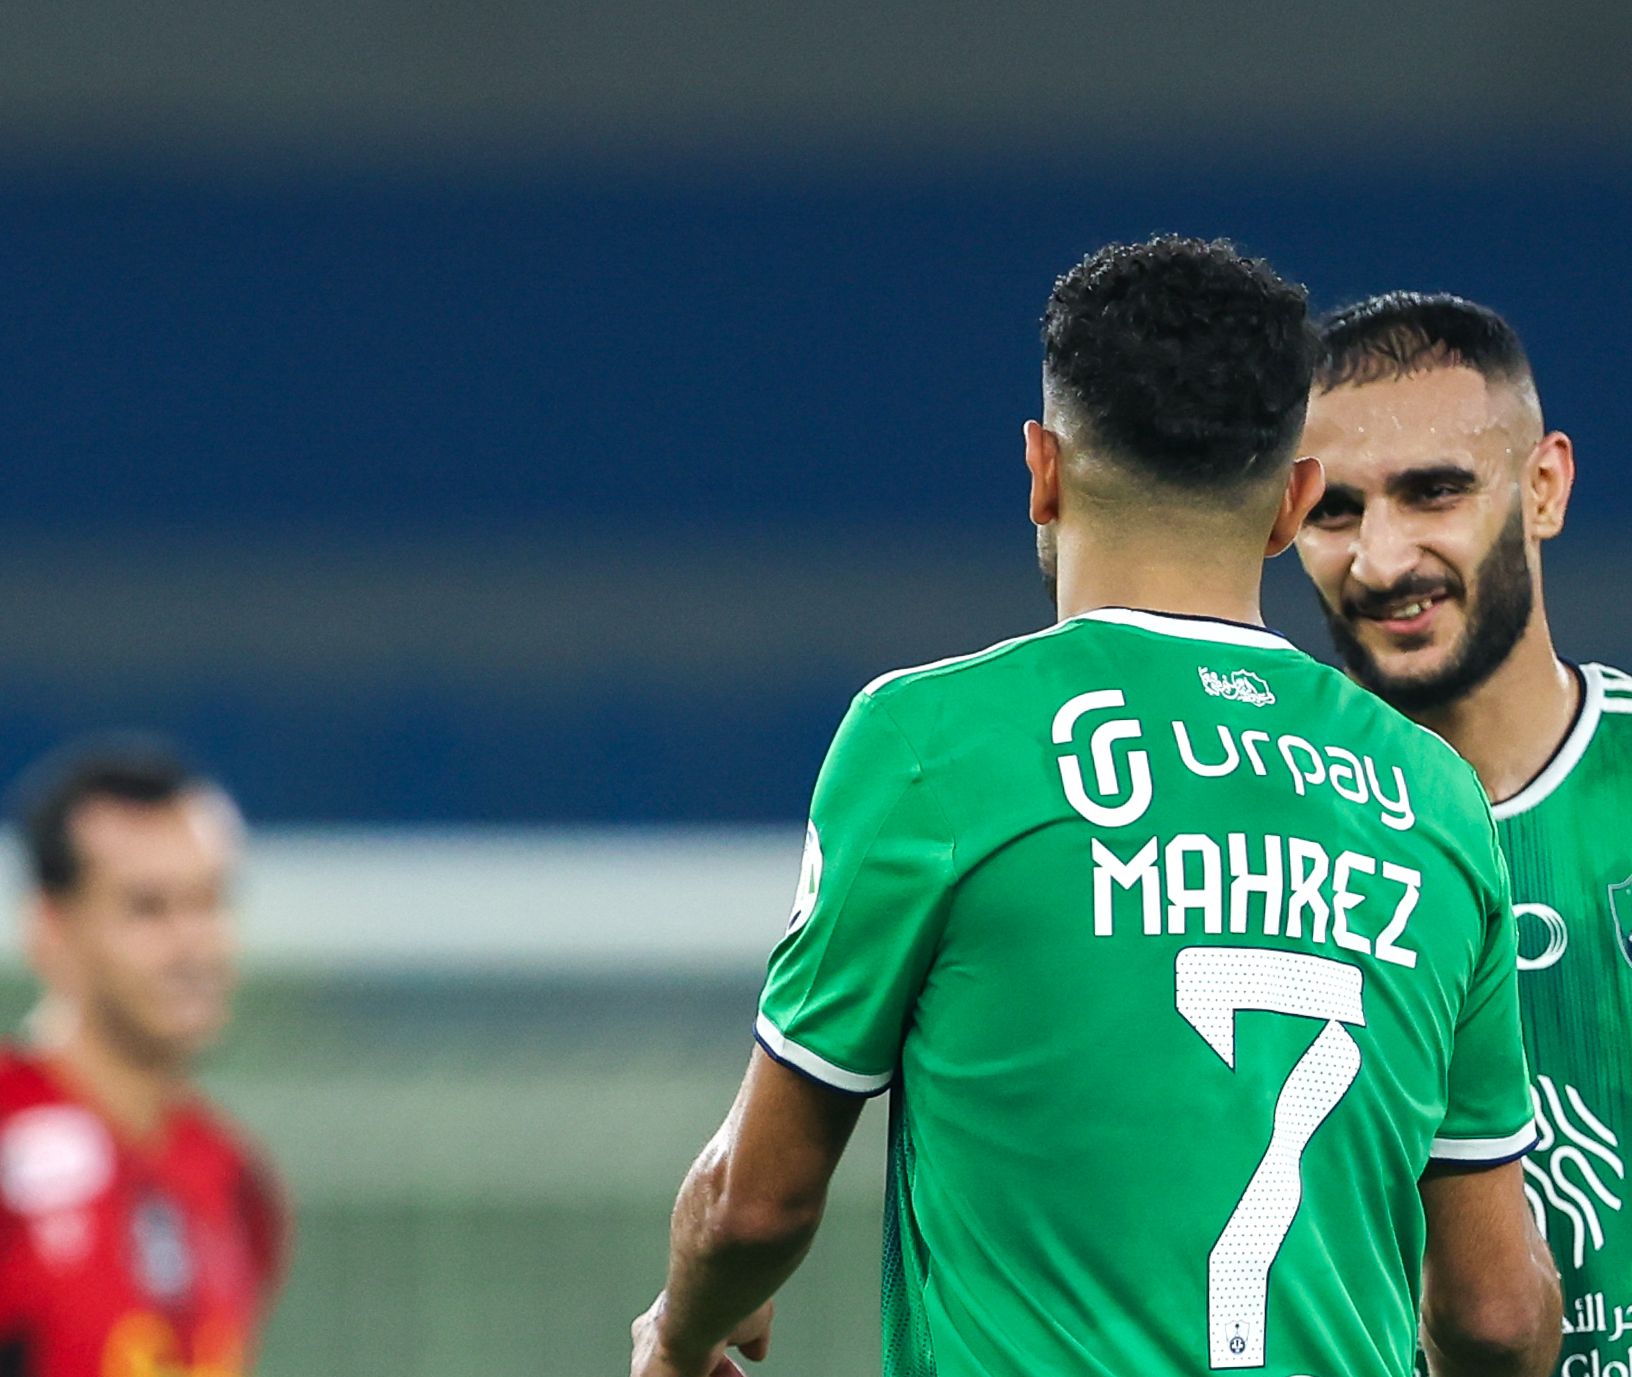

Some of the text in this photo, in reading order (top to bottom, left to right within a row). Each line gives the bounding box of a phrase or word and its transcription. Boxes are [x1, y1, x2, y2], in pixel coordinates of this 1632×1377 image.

[1172, 720, 1416, 831] urpay
[1091, 832, 1422, 969] MAHREZ
[1175, 947, 1366, 1369] 7
